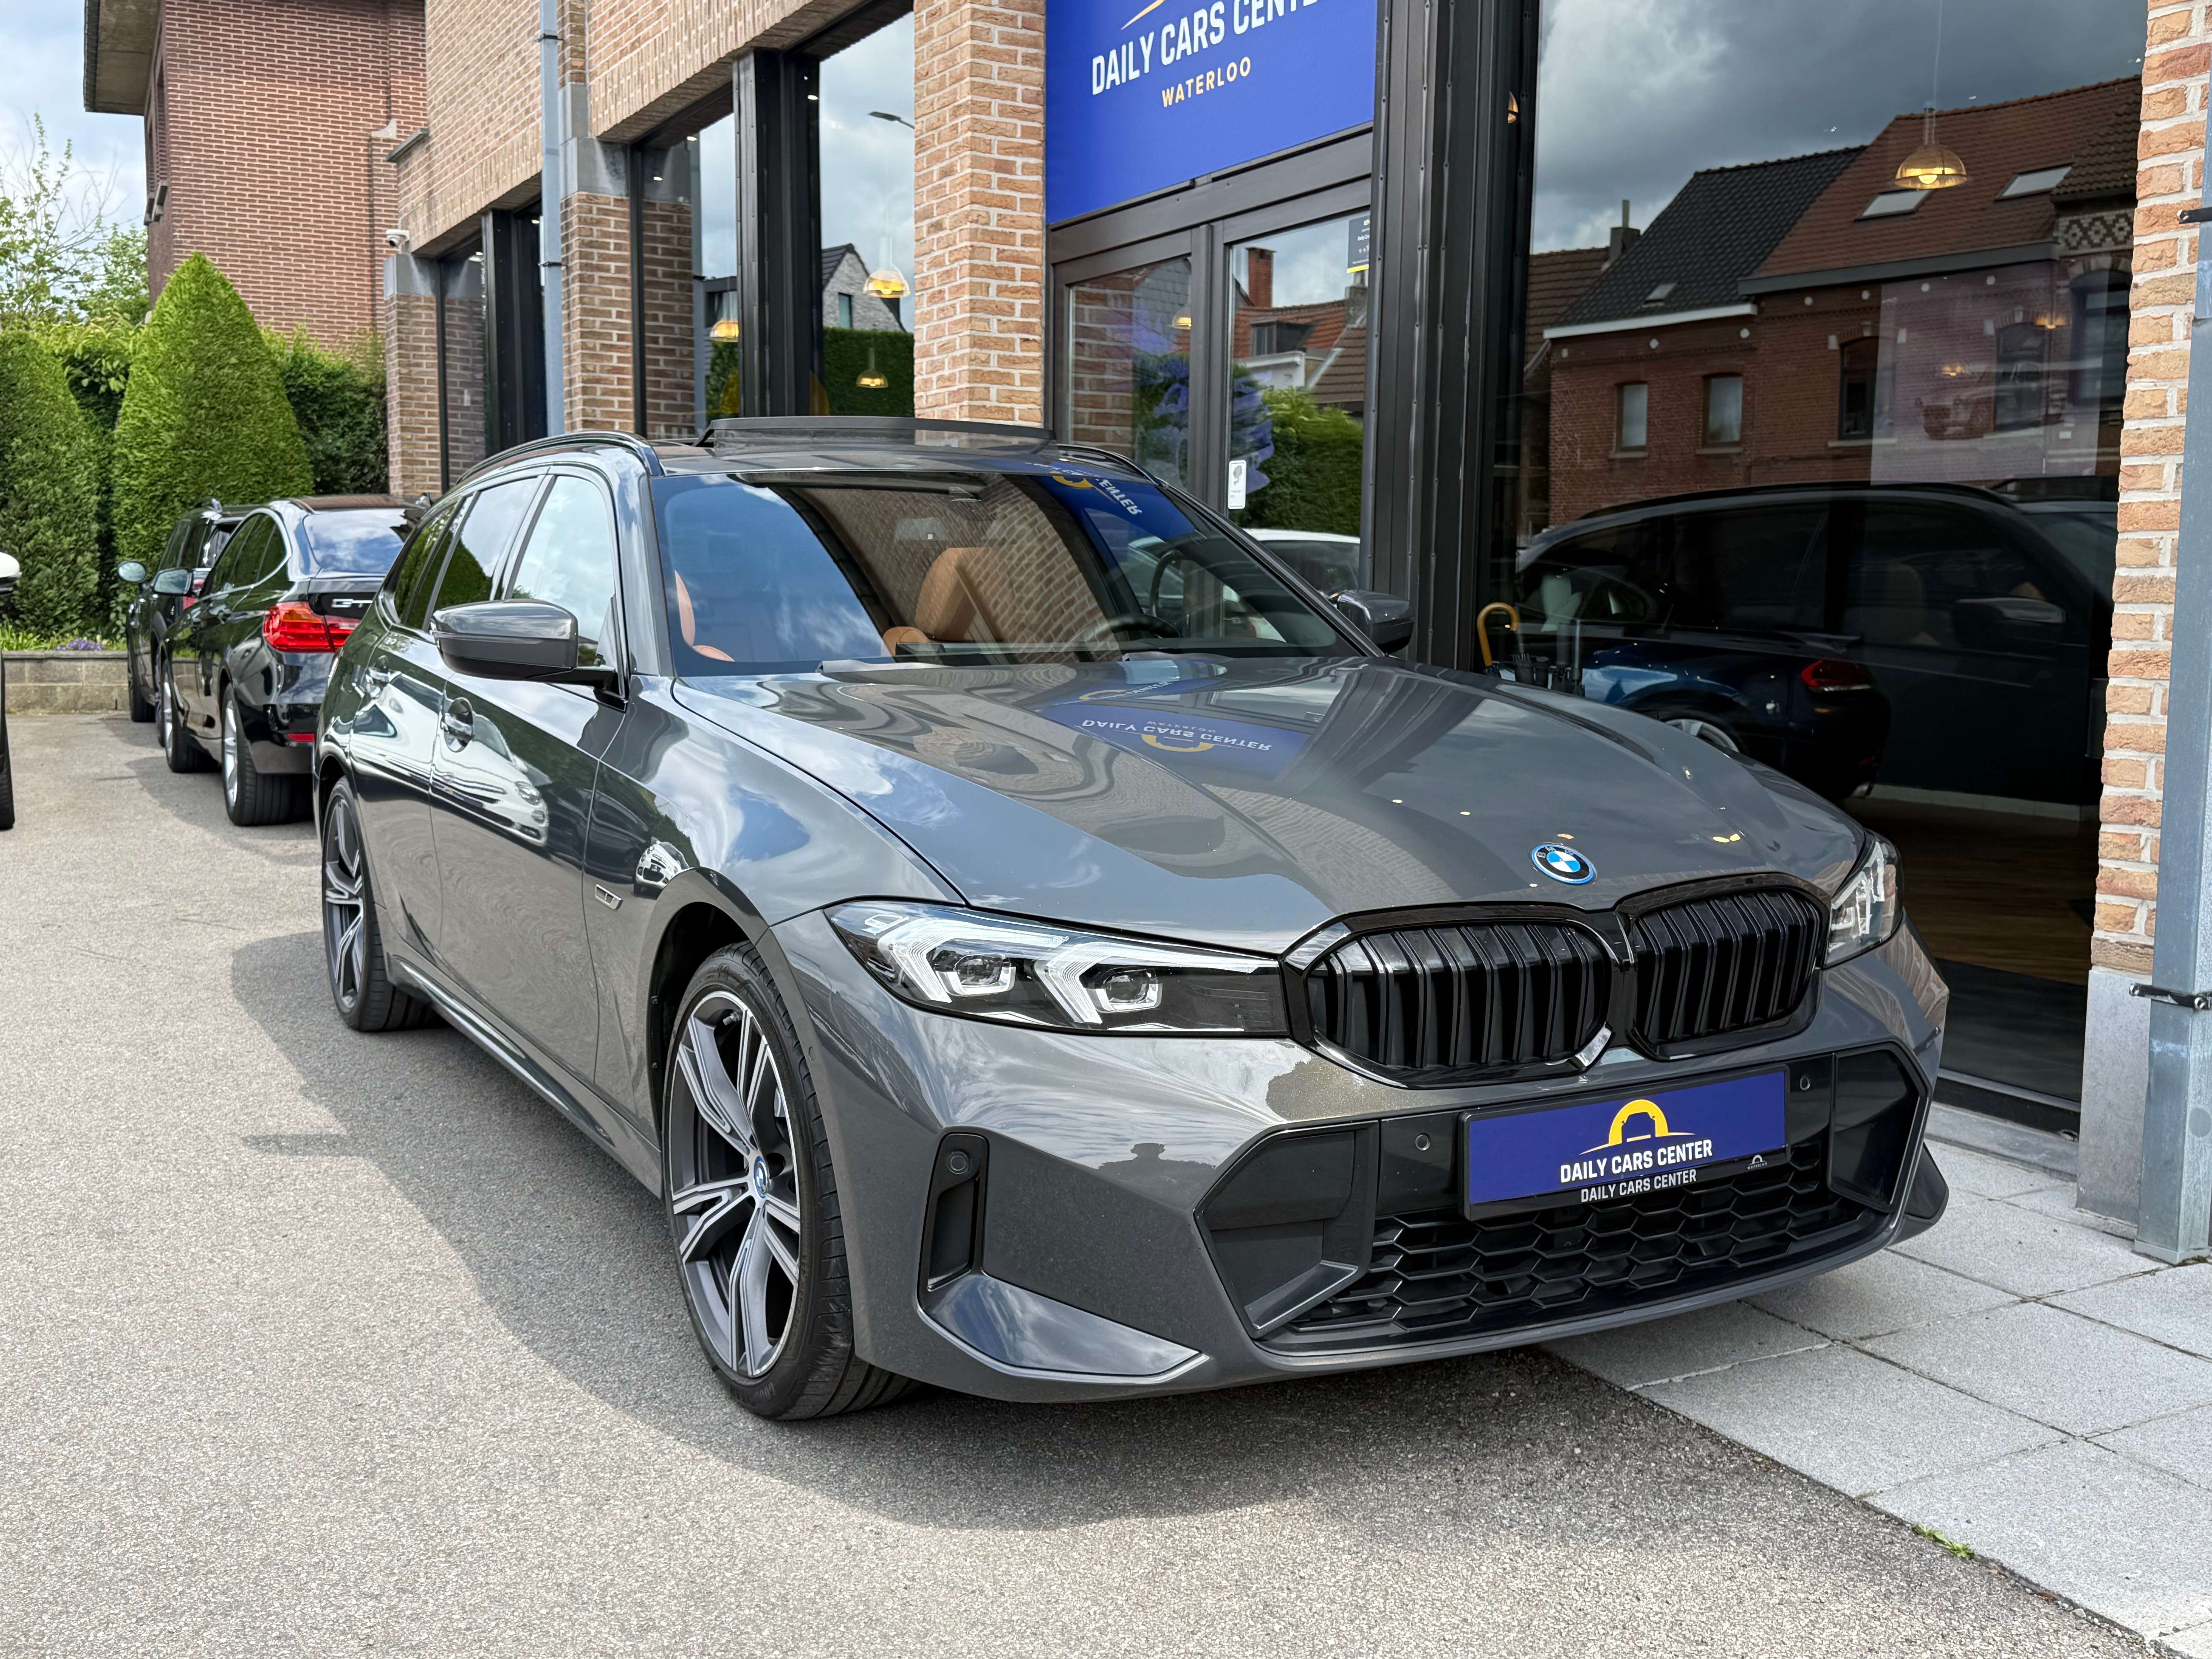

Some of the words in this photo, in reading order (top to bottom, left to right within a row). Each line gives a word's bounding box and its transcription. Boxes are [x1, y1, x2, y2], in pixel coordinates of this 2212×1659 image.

[1092, 32, 1154, 95] DAILY
[1161, 1, 1224, 65] CARS
[1162, 57, 1251, 108] WATERLOO
[1561, 1158, 1607, 1183] DAILY
[1612, 1151, 1653, 1174] CARS
[1657, 1139, 1713, 1166] CENTER
[1581, 1184, 1616, 1202] DAILY
[1620, 1178, 1650, 1195] CARS
[1654, 1169, 1697, 1189] CENTER
